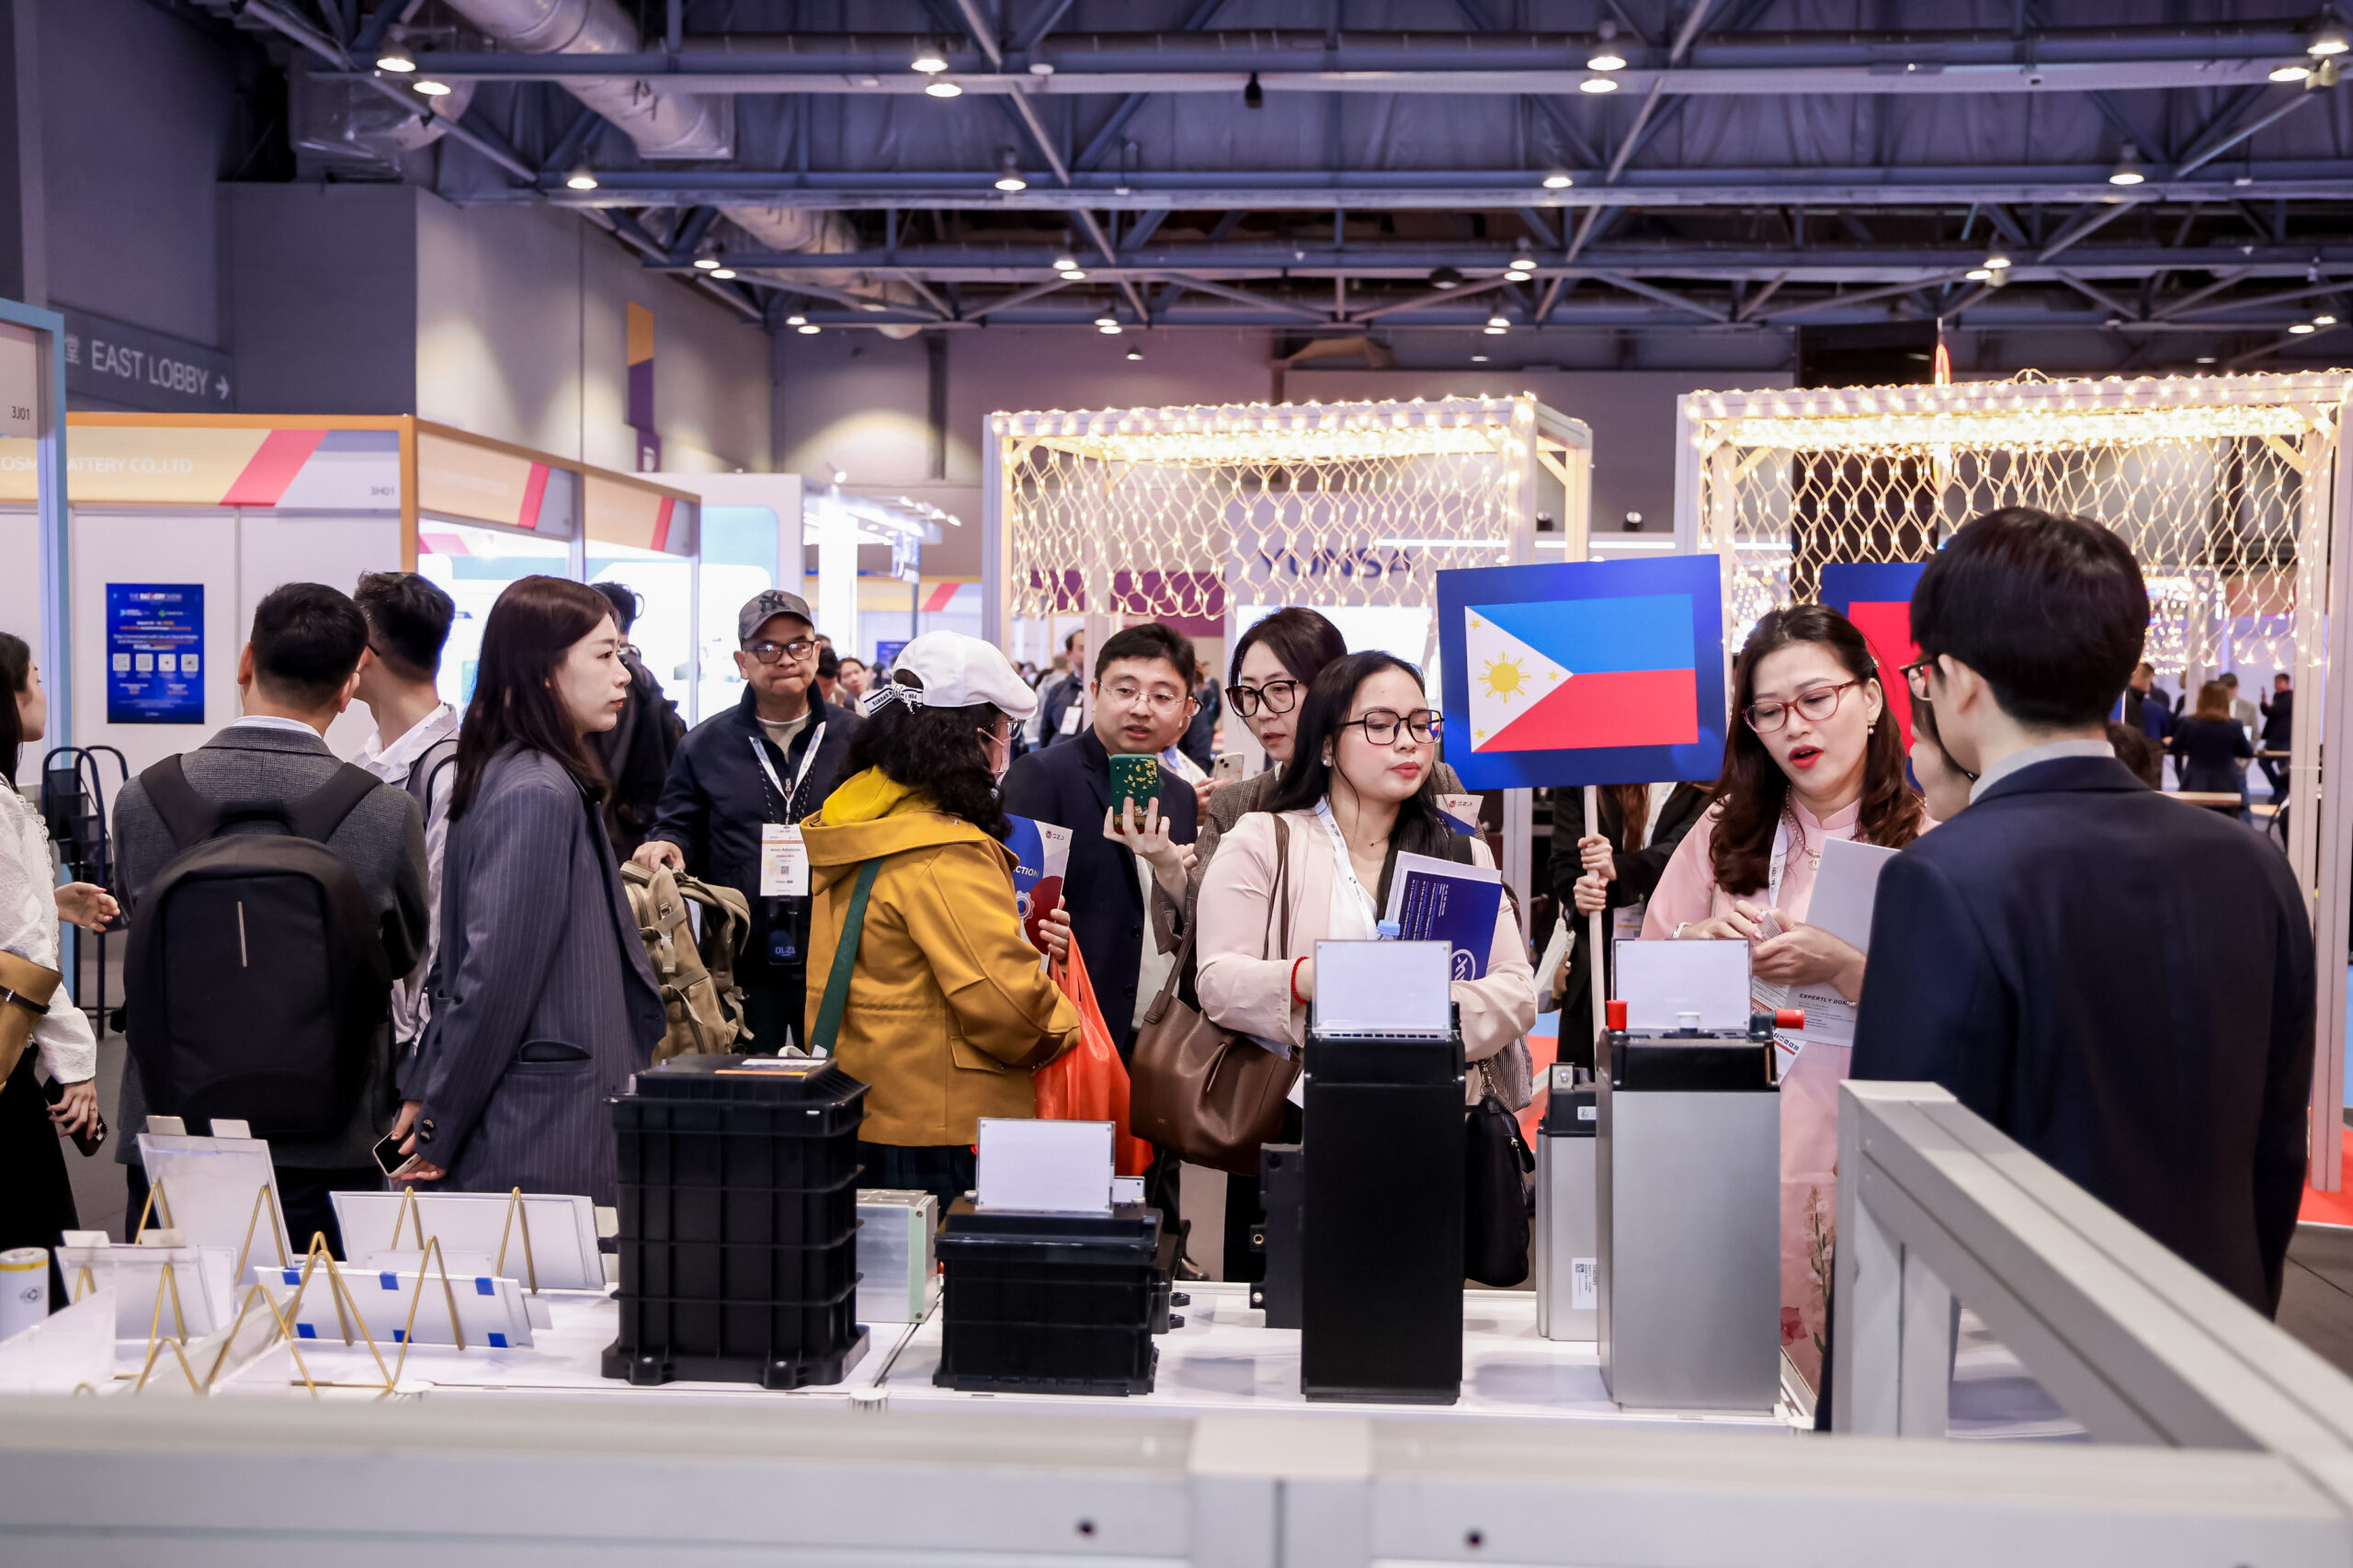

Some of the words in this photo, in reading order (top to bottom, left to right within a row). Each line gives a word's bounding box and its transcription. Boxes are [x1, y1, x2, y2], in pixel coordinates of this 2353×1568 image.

[91, 339, 144, 381] EAST
[148, 353, 209, 396] LOBBY
[11, 405, 30, 421] 3J01
[67, 457, 126, 472] ATTERY
[1013, 865, 1040, 878] CTION
[1799, 993, 1833, 1004] EXPERTLY
